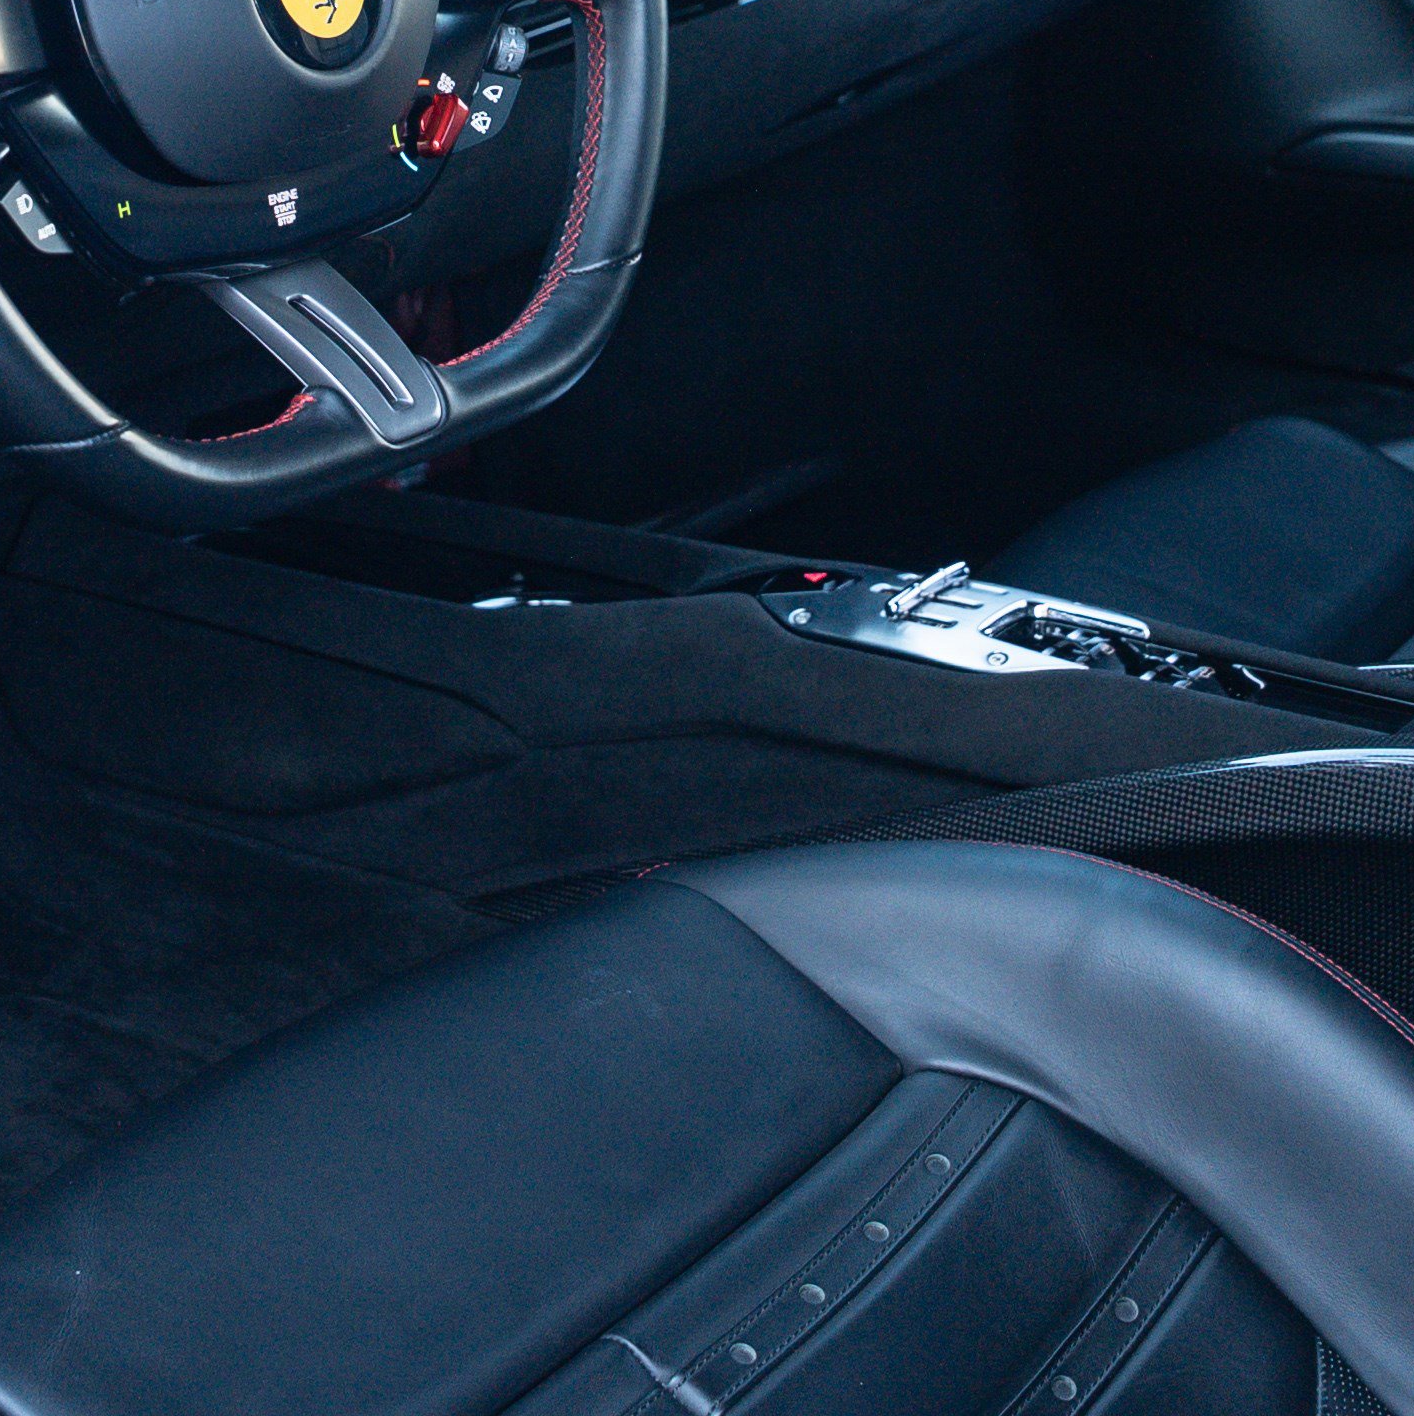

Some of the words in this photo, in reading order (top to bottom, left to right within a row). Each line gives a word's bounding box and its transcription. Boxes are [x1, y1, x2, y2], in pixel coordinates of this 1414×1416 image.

[268, 188, 299, 206] ENGINE
[274, 201, 296, 215] START
[277, 214, 297, 226] STOP
